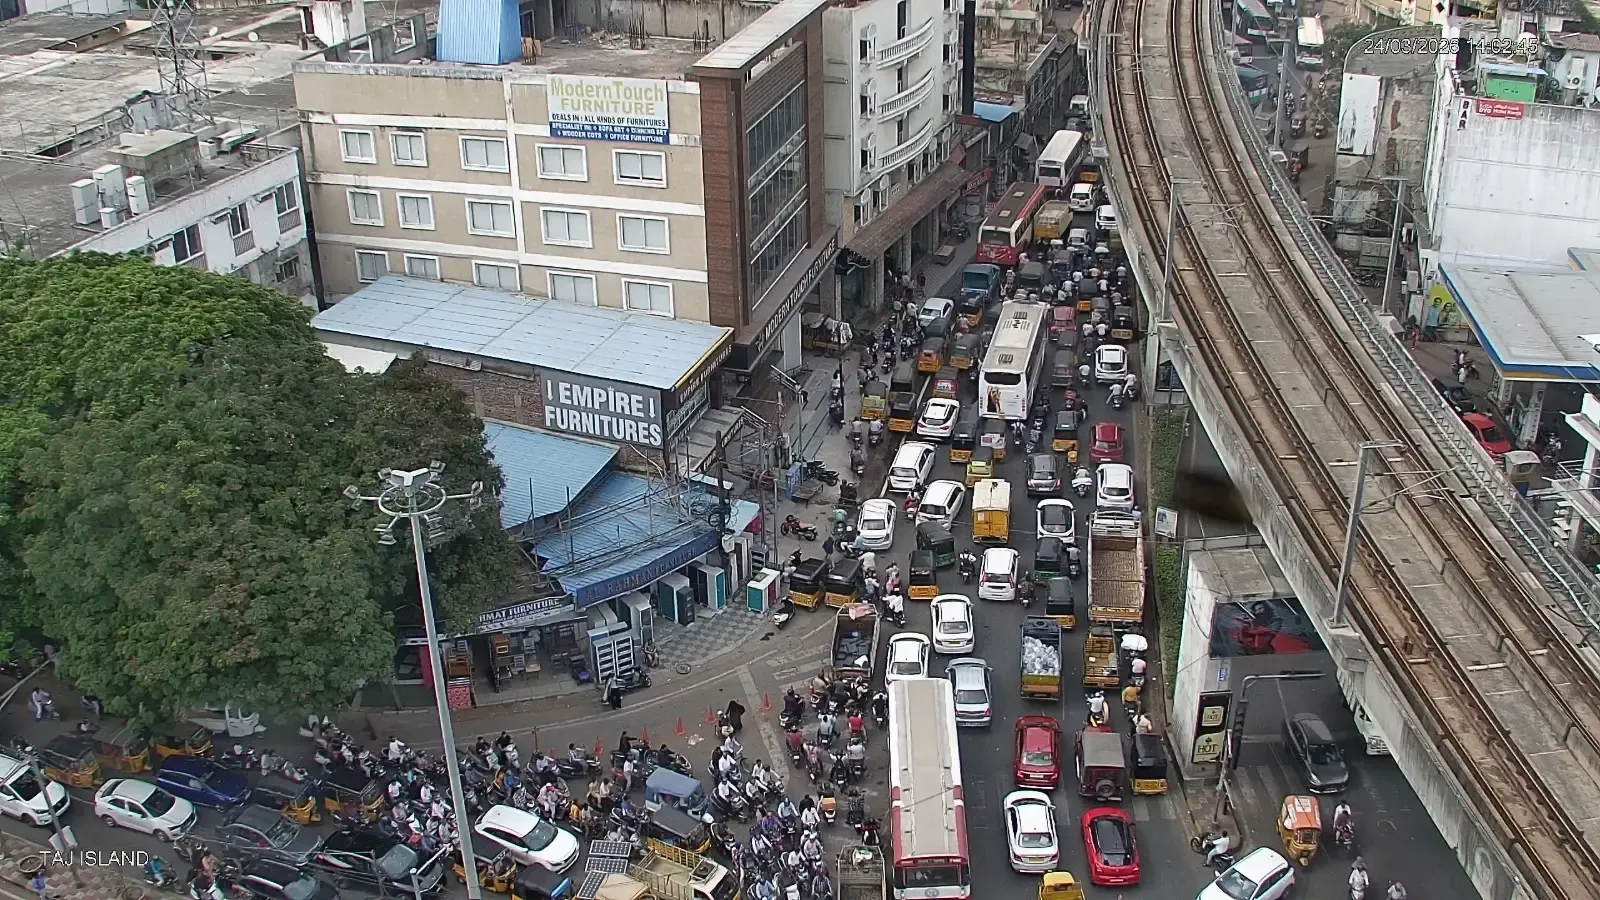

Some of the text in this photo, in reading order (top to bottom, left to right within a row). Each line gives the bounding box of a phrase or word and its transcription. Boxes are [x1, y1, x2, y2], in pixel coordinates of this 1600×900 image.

[561, 98, 656, 116] FURNITURE
[1459, 100, 1470, 129] BAR
[552, 113, 572, 121] DEALS
[585, 115, 596, 123] ALL
[596, 116, 616, 124] KINDS
[617, 117, 625, 125] OF
[626, 117, 666, 127] FURNITURES
[630, 134, 663, 143] FURNITURE
[765, 301, 790, 341] MODERN
[558, 382, 645, 418] EMPIRE
[544, 405, 662, 447] FURNITURES
[479, 610, 506, 623] HMAT
[509, 598, 560, 616] FURNITURE
[1197, 744, 1218, 753] HOT
